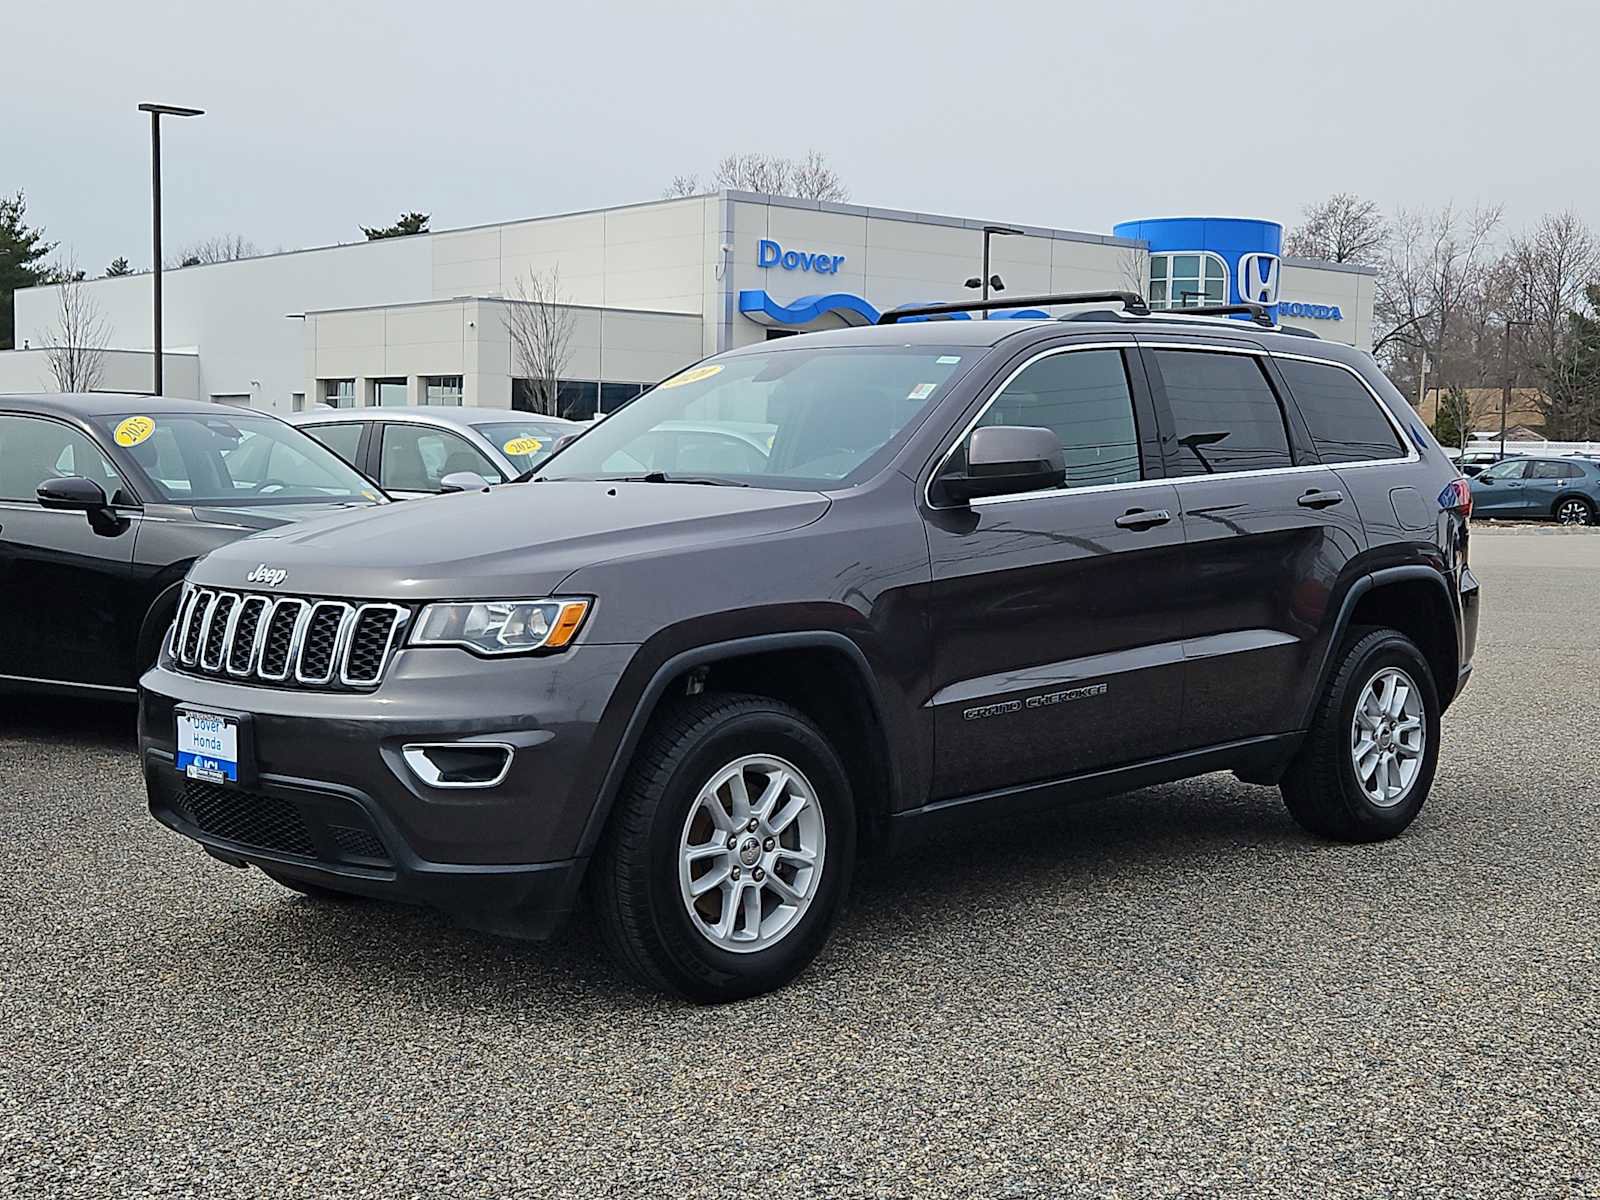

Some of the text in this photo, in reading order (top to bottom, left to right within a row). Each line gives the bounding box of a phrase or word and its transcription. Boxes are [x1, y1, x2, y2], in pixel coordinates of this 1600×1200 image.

[758, 239, 845, 275] Dover
[1278, 301, 1343, 320] HONDA
[120, 419, 148, 442] 2025
[247, 563, 288, 588] Jeep
[963, 683, 1108, 721] GRAND CHEROKEE
[193, 733, 222, 751] Honda
